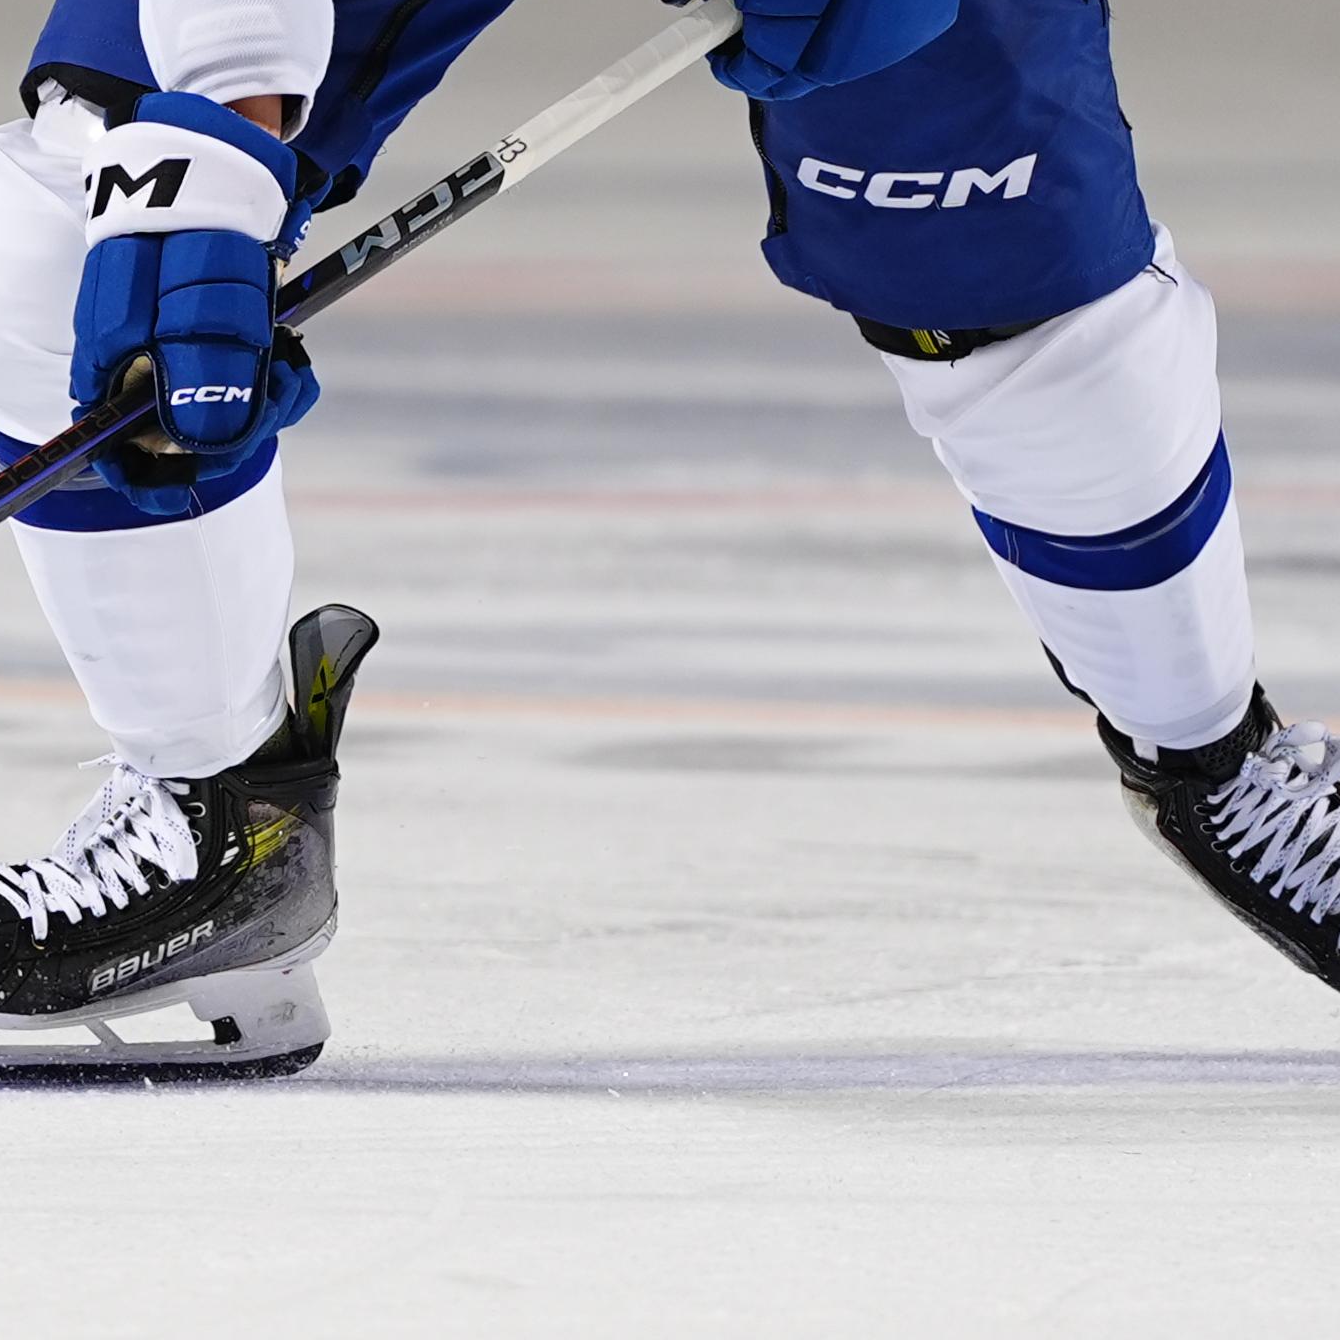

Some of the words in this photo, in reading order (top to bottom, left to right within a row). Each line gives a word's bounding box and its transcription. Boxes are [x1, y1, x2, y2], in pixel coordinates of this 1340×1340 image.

[497, 133, 528, 164] 43
[85, 158, 192, 220] M
[797, 153, 1038, 209] CCM
[340, 151, 506, 276] CCM
[170, 386, 253, 406] CCM
[91, 920, 214, 992] BAUER
